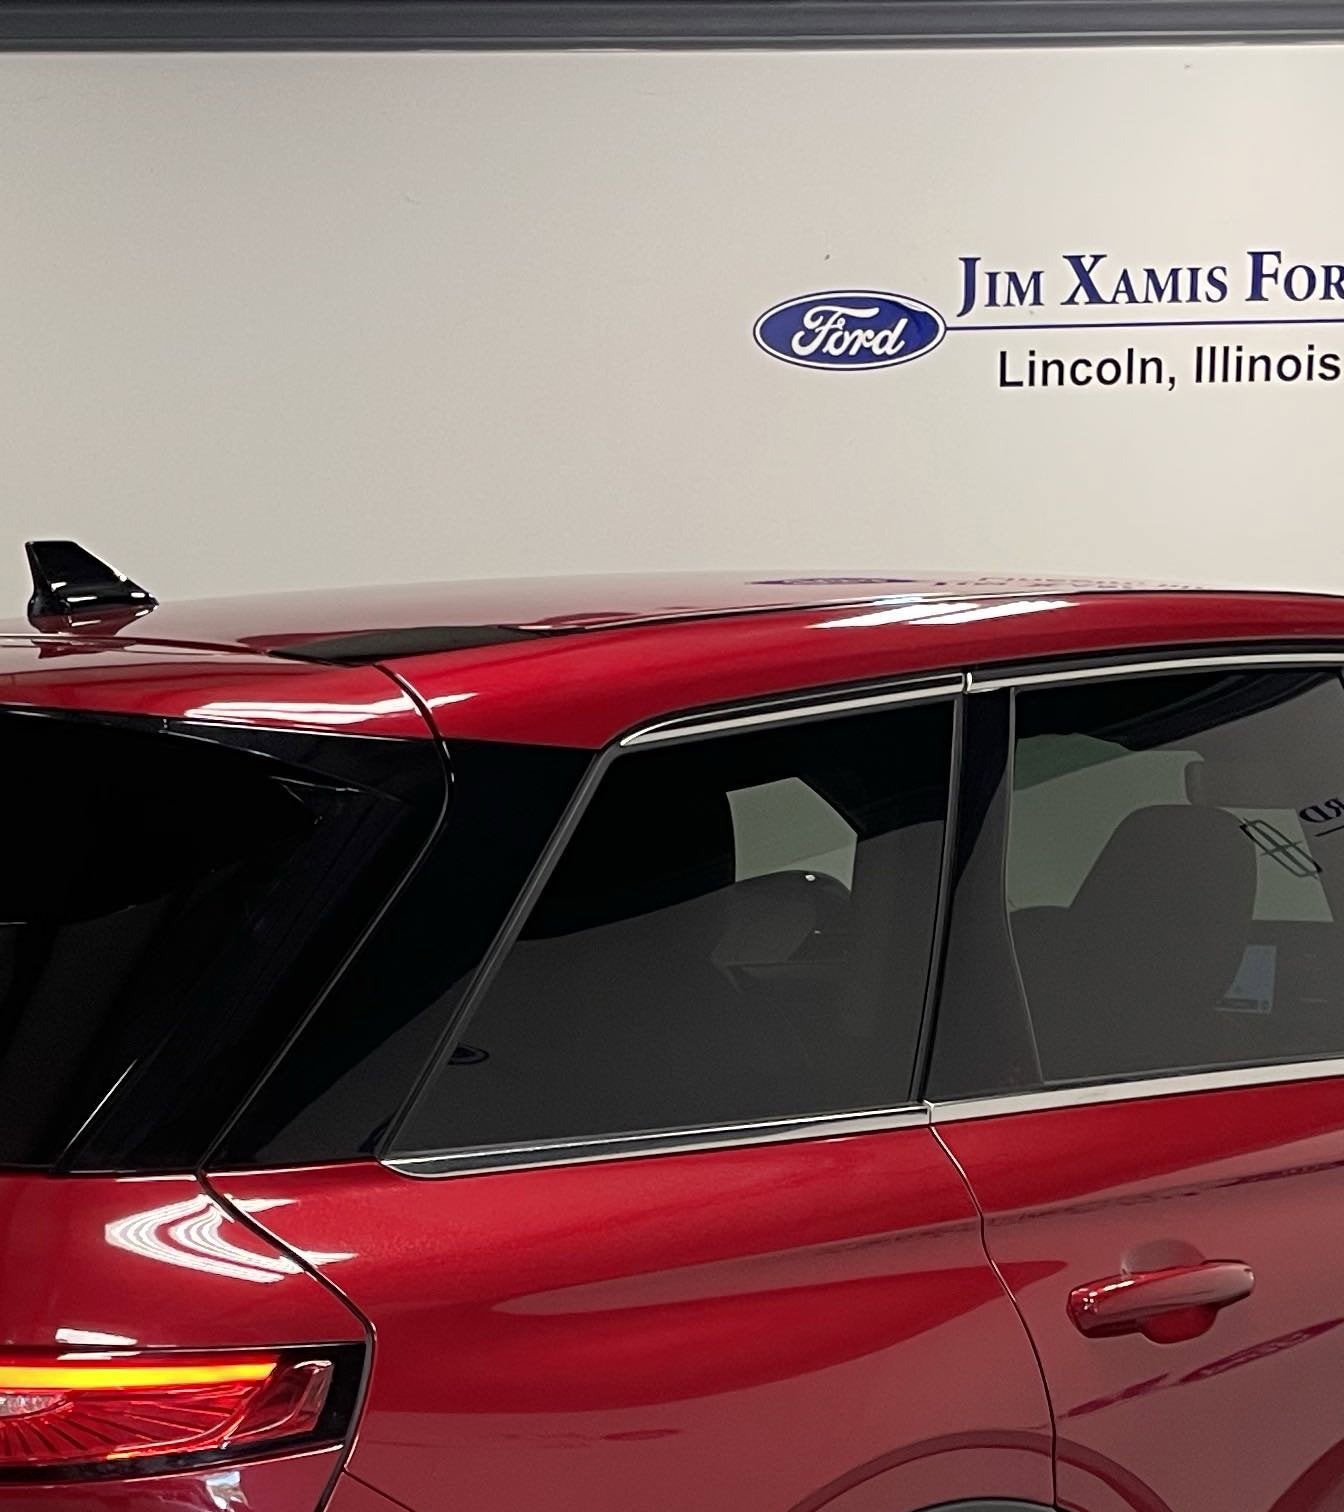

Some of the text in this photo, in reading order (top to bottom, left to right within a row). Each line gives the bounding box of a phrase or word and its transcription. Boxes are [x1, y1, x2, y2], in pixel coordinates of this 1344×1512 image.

[956, 257, 1045, 318] JIM
[1059, 253, 1228, 306] XAMIS
[999, 343, 1341, 392] Lincoln, Illinois
